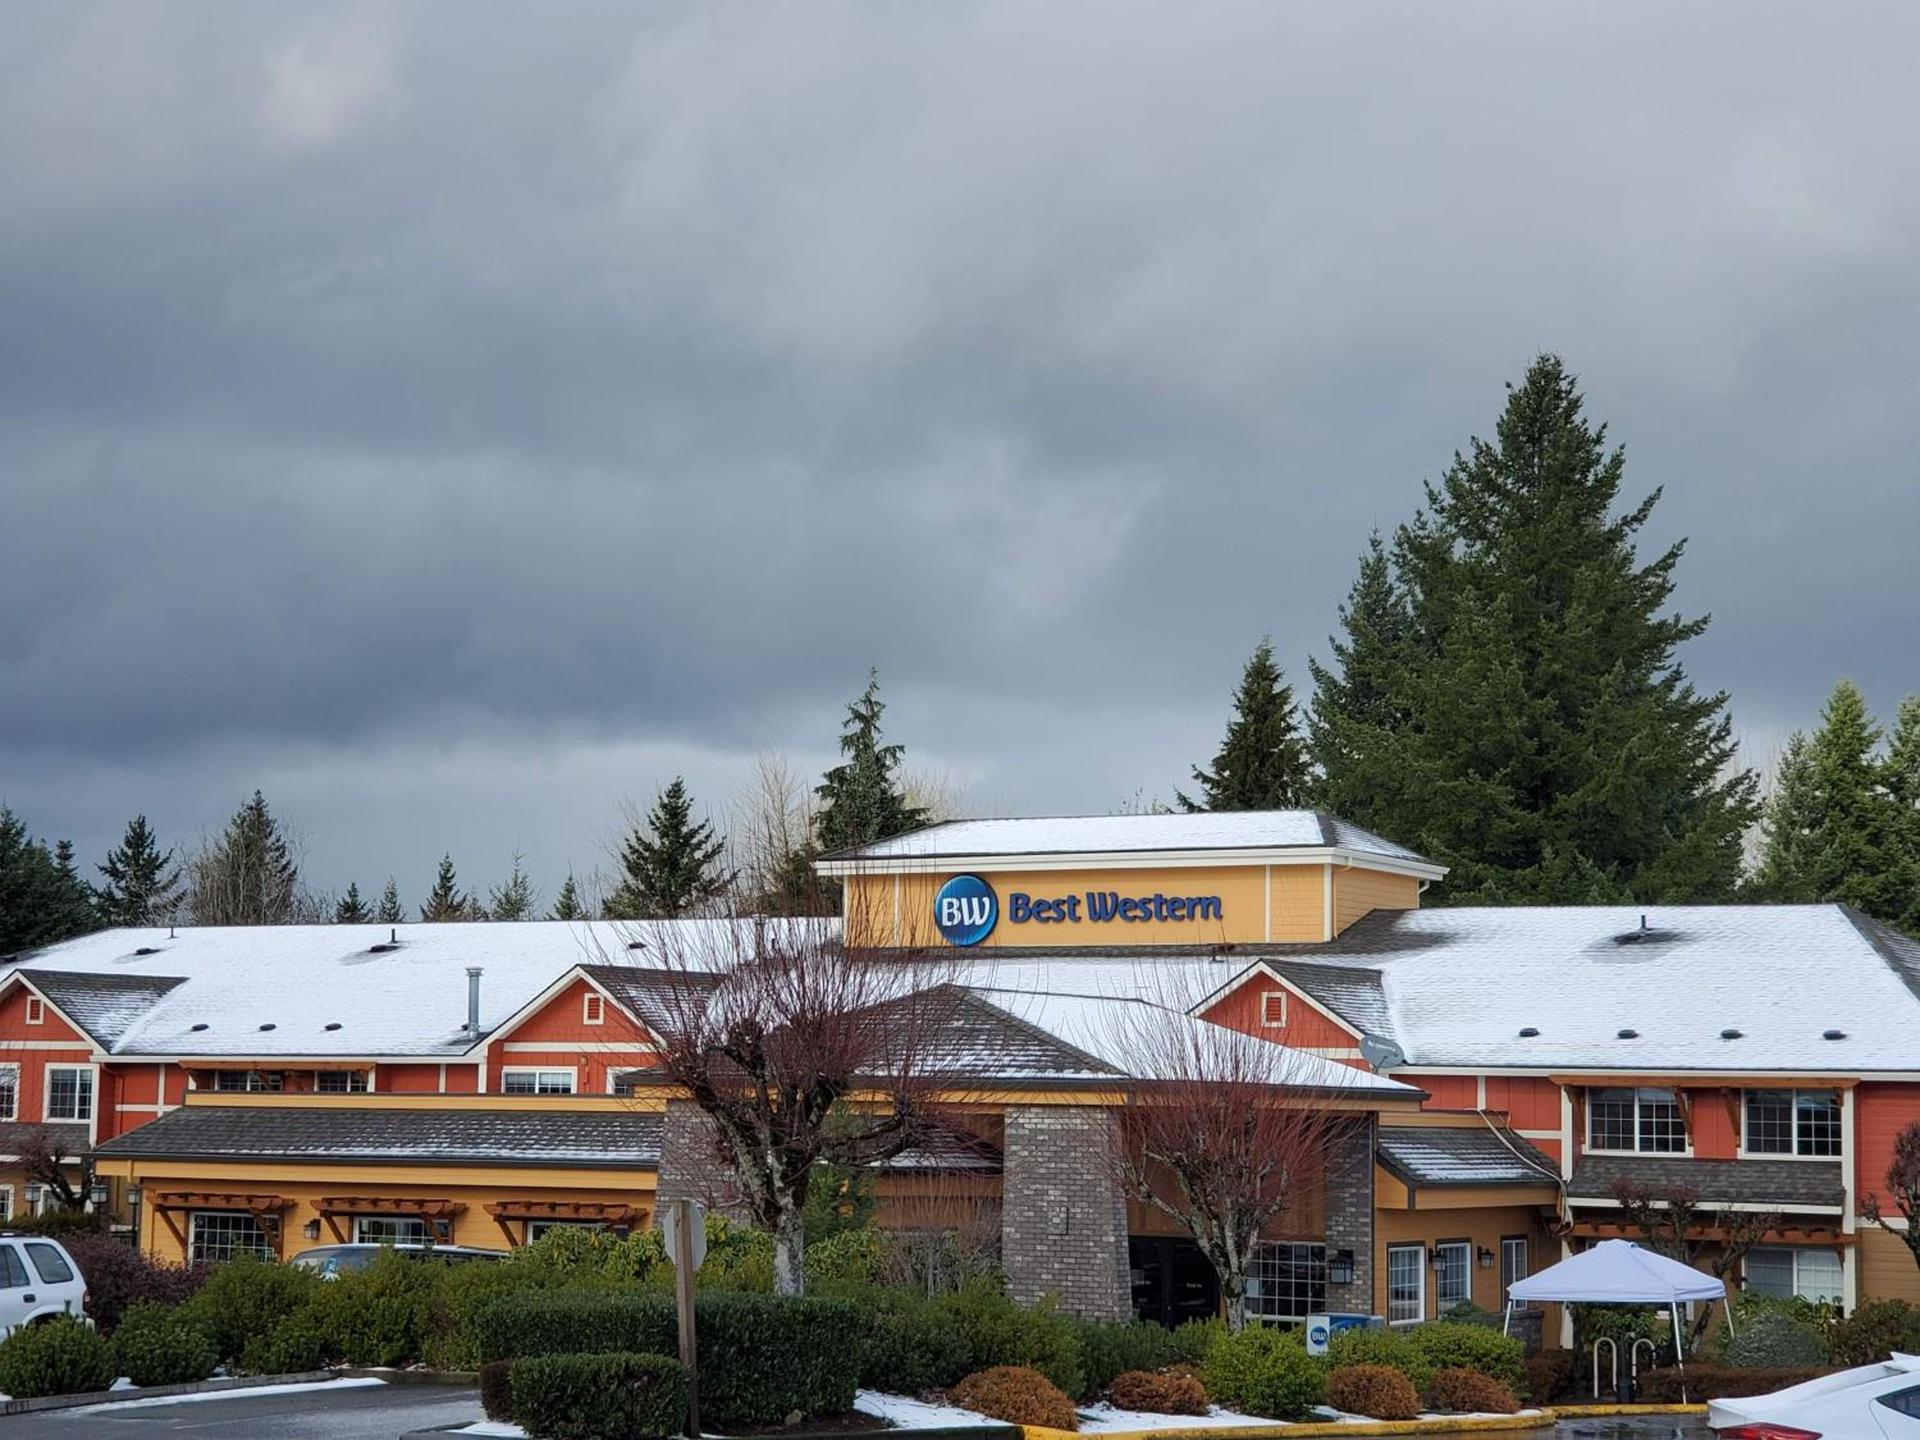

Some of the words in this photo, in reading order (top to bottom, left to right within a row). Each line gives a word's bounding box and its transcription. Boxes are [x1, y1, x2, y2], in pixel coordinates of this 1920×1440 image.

[942, 896, 990, 926] BW
[1009, 892, 1082, 922] Best
[1085, 891, 1223, 922] Western
